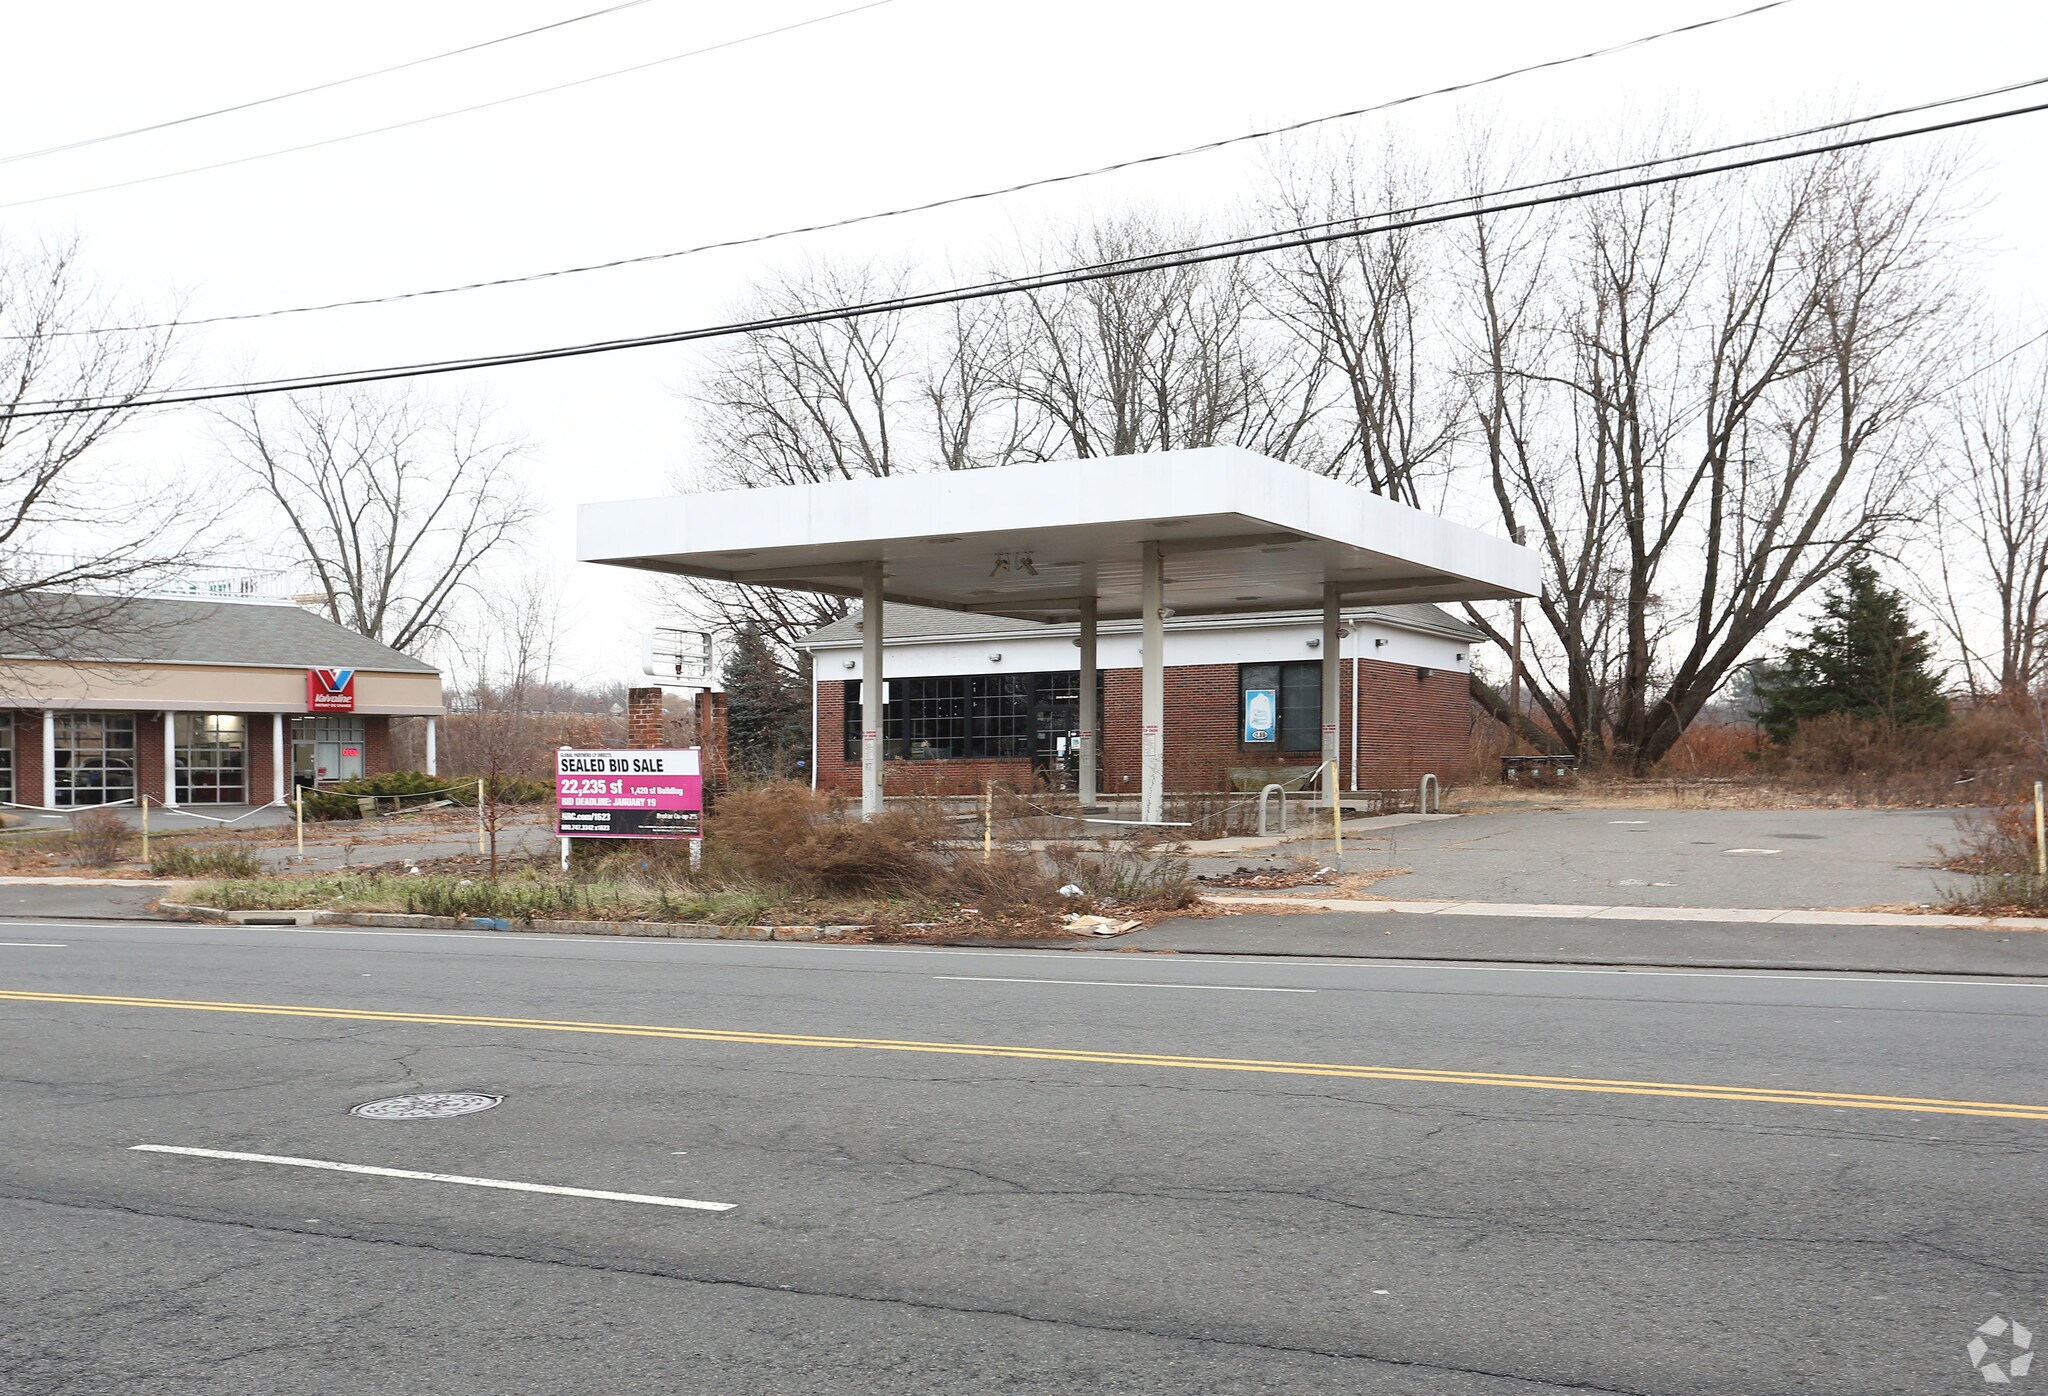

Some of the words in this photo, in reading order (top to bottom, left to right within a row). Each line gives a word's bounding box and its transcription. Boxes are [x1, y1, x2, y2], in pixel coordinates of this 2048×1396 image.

[315, 694, 352, 703] Valvoline
[342, 748, 359, 756] OPEN
[561, 759, 605, 772] SEALED
[609, 759, 629, 772] BID
[633, 759, 664, 772] SALE
[561, 779, 606, 796] 22,235
[610, 780, 623, 794] sf
[656, 787, 683, 796] Building
[561, 798, 574, 806] BID
[575, 798, 612, 806] DEADLINE:
[612, 798, 646, 806] JANUARY
